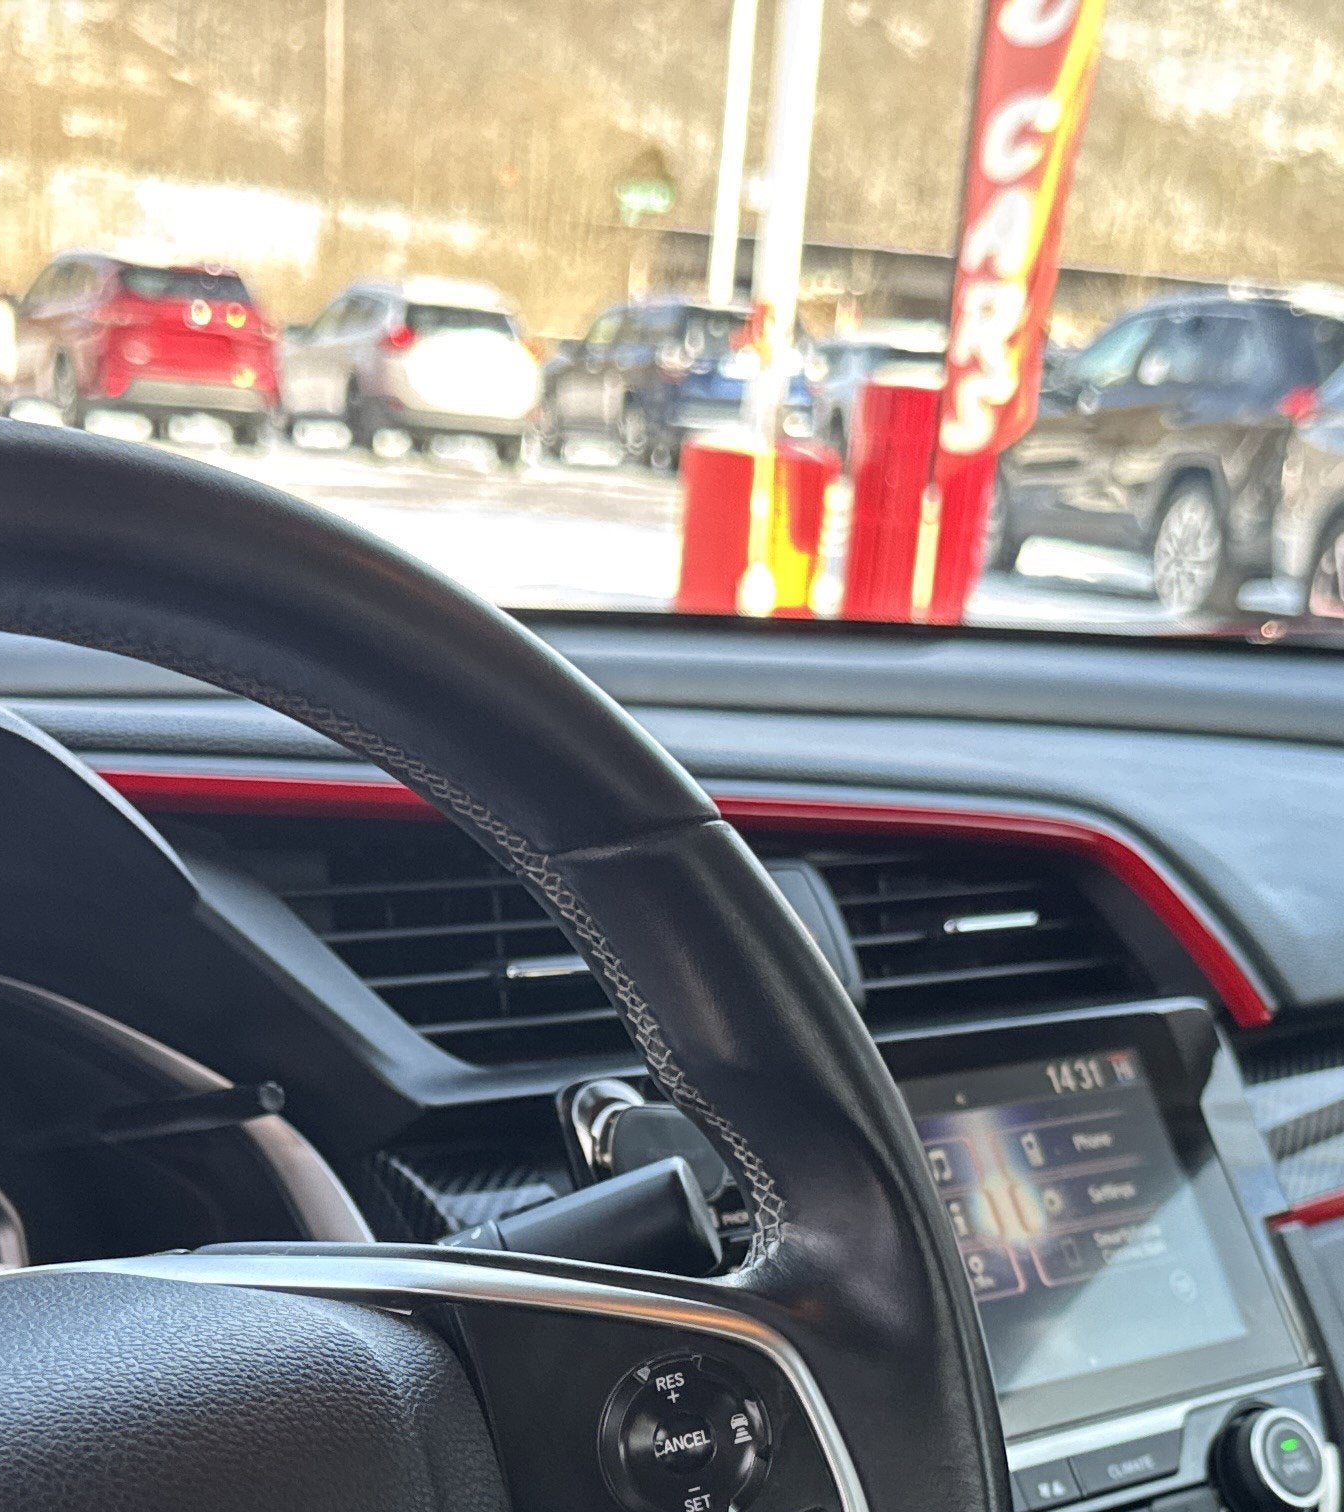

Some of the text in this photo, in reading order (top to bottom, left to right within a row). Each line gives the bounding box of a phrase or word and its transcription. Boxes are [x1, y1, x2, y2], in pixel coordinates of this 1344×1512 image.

[939, 92, 1063, 454] CARS
[655, 1371, 685, 1393] RES
[654, 1429, 711, 1458] CANCEL
